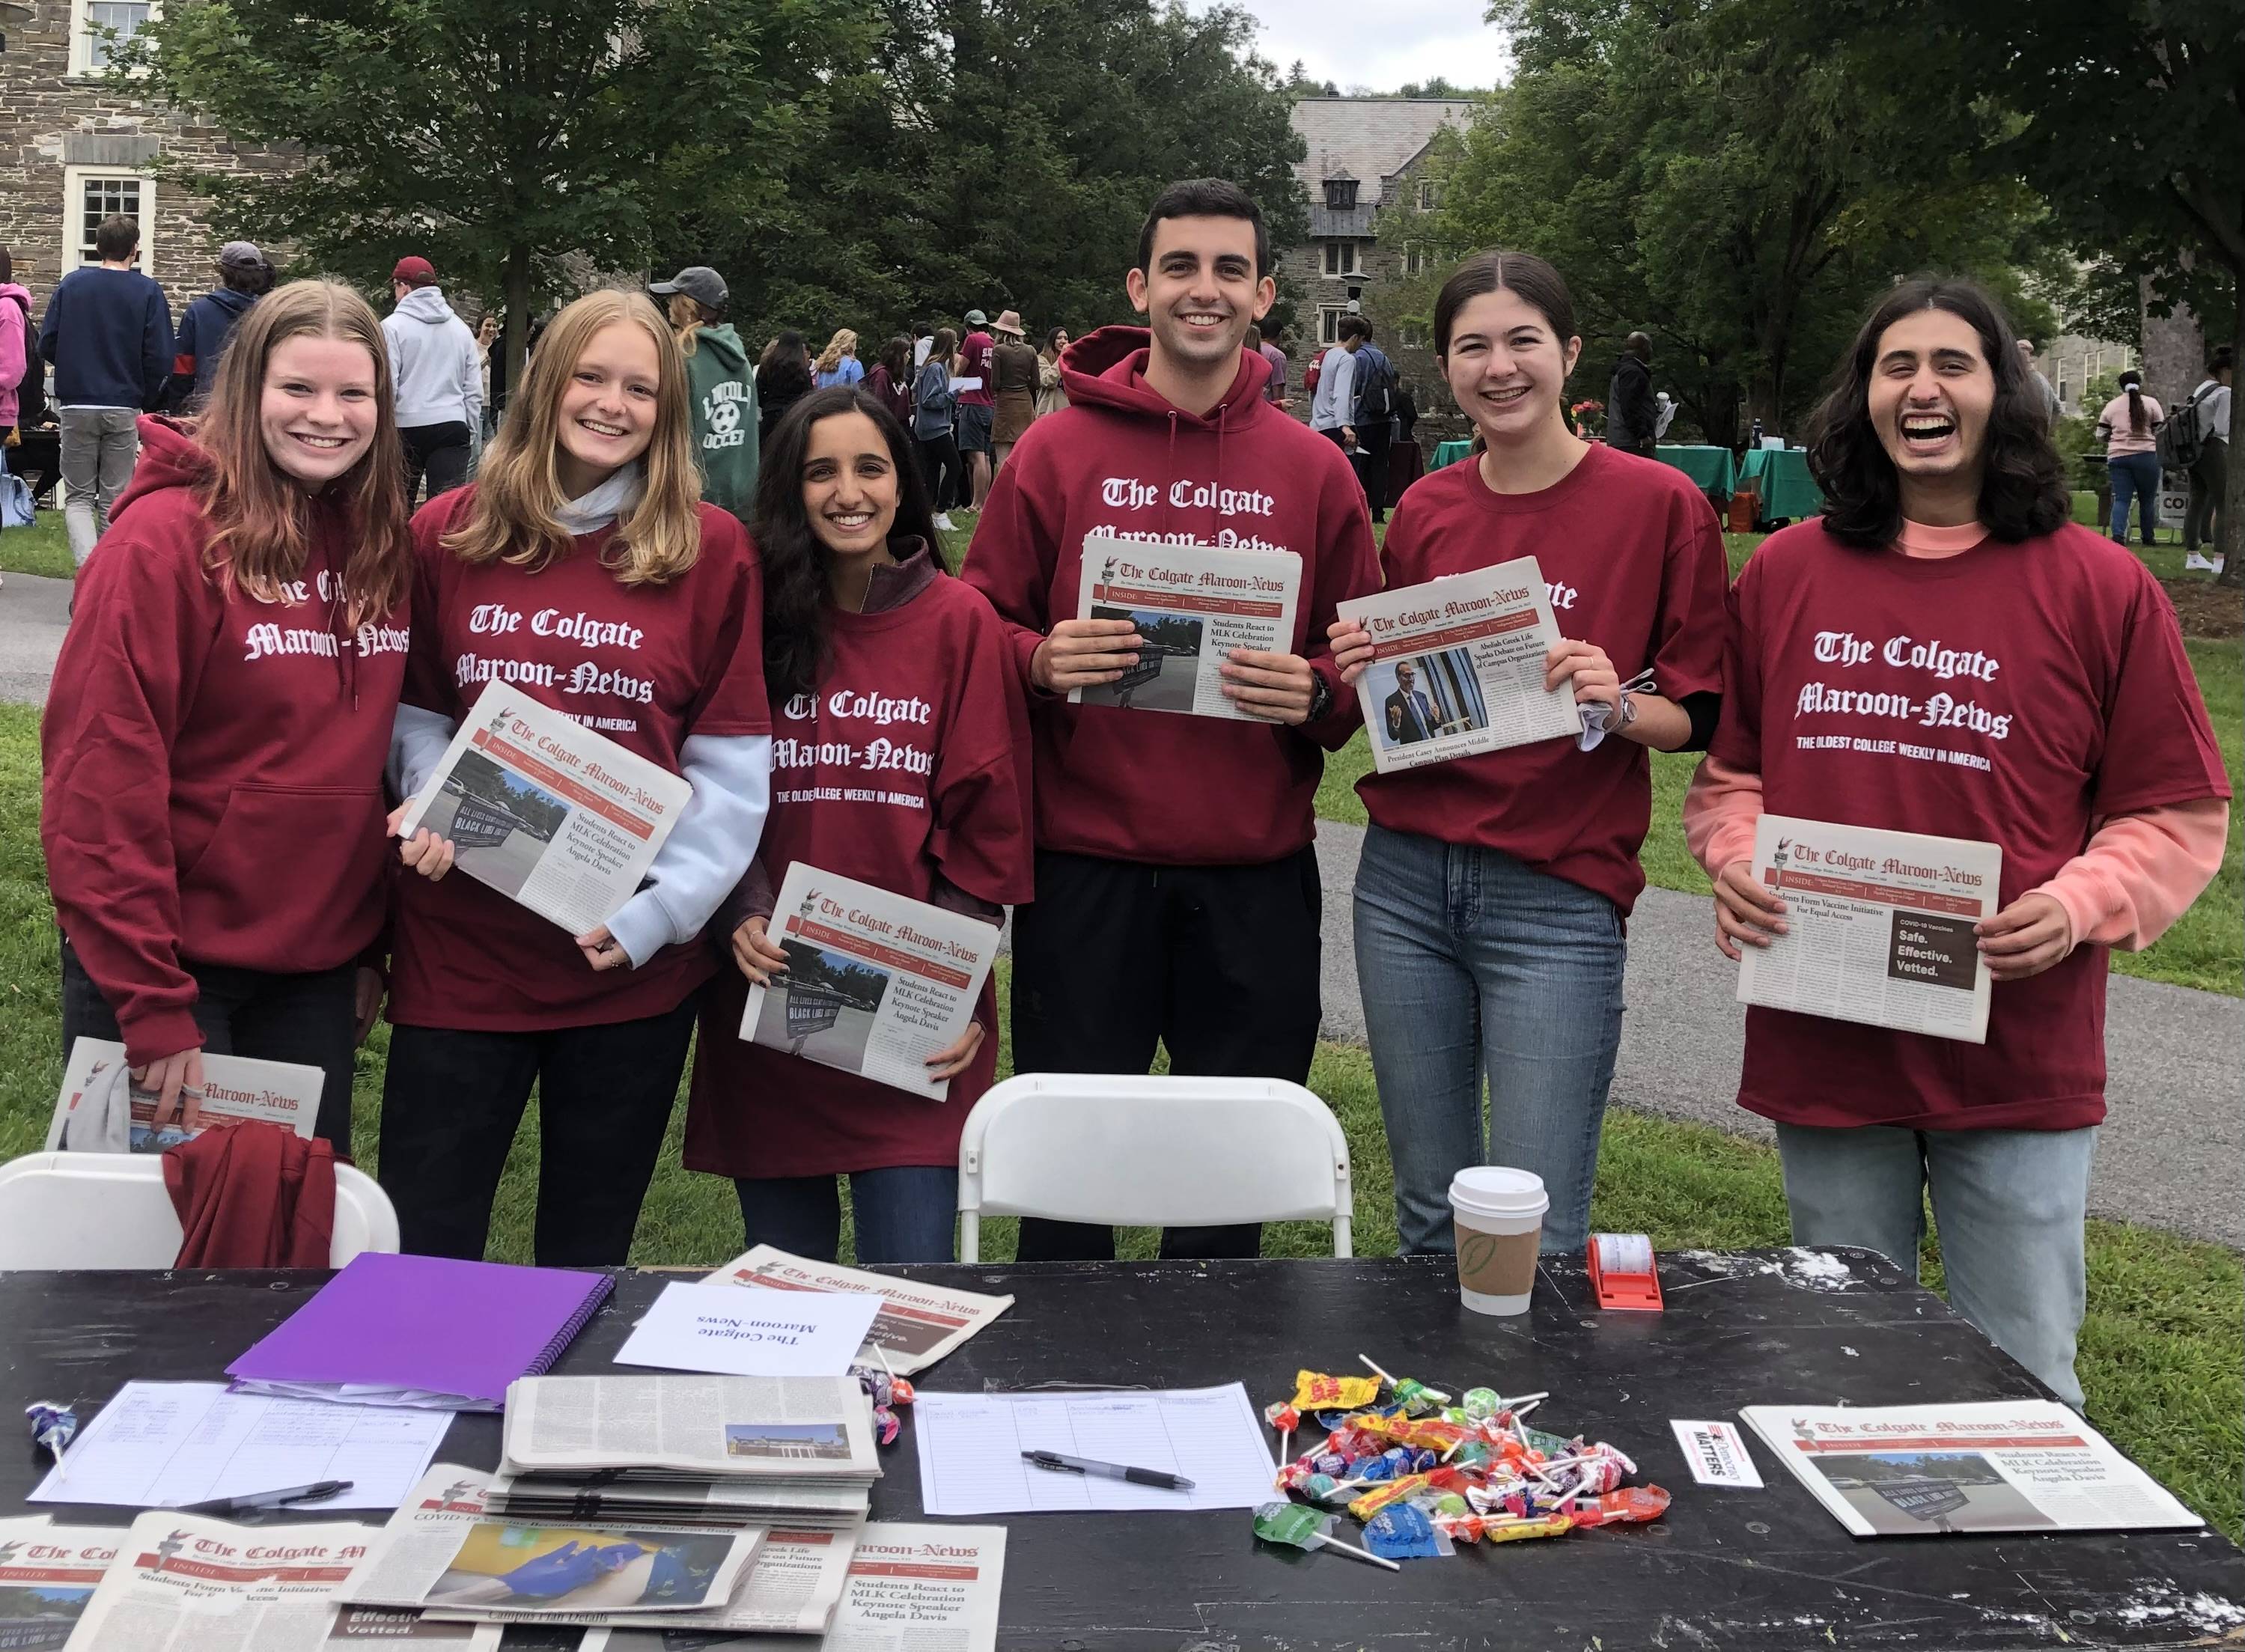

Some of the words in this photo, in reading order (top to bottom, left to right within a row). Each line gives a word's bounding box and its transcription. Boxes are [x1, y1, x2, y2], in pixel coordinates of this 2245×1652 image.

[1102, 478, 1159, 511] The
[1169, 479, 1274, 516] Colgate
[1120, 563, 1144, 579] The
[1149, 567, 1194, 585] Colgate
[1198, 572, 1285, 592] Maroon-News
[1372, 616, 1395, 632] The
[1398, 609, 1440, 627] Colgate
[1444, 585, 1530, 618] Maroon-News
[469, 603, 523, 636] The
[531, 608, 644, 650] Colgate
[1213, 619, 1244, 630] Students
[1246, 622, 1266, 631] React
[244, 623, 409, 661] Maroon-News
[1210, 629, 1231, 637] MLK
[1232, 630, 1274, 642] Celebration
[1211, 638, 1241, 649] Keynote
[1243, 640, 1272, 652] Speaker
[1481, 641, 1502, 650] Abolish
[1502, 635, 1521, 646] Greek
[1521, 633, 1533, 641] Life
[1216, 649, 1231, 659] Ang
[1474, 651, 1493, 662] Sparks
[1494, 647, 1515, 657] Debate
[1525, 641, 1545, 650] Future
[1508, 649, 1550, 663] Organizations
[1814, 631, 1874, 668] The
[1883, 635, 1999, 682] Colgate
[455, 652, 655, 704] Maroon-News
[829, 690, 930, 725] Colgate
[1794, 682, 2013, 740] Maroon-News
[583, 715, 597, 728] IN
[596, 716, 637, 732] AMERICA
[1388, 753, 1414, 763] President
[1416, 749, 1432, 757] Casey
[1434, 743, 1467, 753] Announces
[1468, 737, 1490, 746] Middle
[1410, 758, 1434, 767] Campus
[1435, 754, 1449, 763] Plan
[1449, 749, 1471, 760] Details
[1797, 737, 1815, 749] THE
[1816, 736, 1851, 749] OLDEST
[1853, 738, 1896, 754] COLLEGE
[1899, 742, 1935, 761] WEEKLY
[1937, 750, 1947, 763] IN
[1948, 752, 1991, 772] AMERICA
[511, 719, 535, 742] The
[537, 735, 582, 767] Colgate
[581, 761, 666, 815] Maroon-News
[777, 790, 789, 802] THE
[843, 788, 875, 802] WEEKLY
[877, 790, 886, 802] IN
[887, 793, 924, 809] AMERICA
[455, 817, 480, 833] BLACK
[578, 812, 606, 833] Students
[608, 829, 627, 846] React
[627, 842, 636, 850] to
[566, 832, 596, 853] Keynote
[598, 850, 624, 869] Speaker
[570, 821, 589, 837] MLK
[591, 833, 631, 861] Celebration
[566, 846, 591, 864] Angela
[592, 859, 612, 876] Davis
[1794, 844, 1820, 862] The
[1825, 850, 1876, 871] Colgate
[1880, 858, 1982, 887] Maroon-News
[1796, 904, 1808, 915] For
[1809, 906, 1830, 918] Equal
[1831, 910, 1853, 921] Access
[1801, 895, 1820, 906] Form
[1821, 899, 1850, 912] Vaccine
[1851, 903, 1884, 916] Initiative
[820, 898, 845, 918] The
[848, 909, 892, 934] Colgate
[892, 925, 979, 963] Maroon-News
[1900, 918, 1928, 928] COVID-19
[1898, 930, 1928, 944] Safe.
[1898, 945, 1952, 964] Effective.
[1896, 960, 1938, 977] Vetted.
[898, 976, 928, 993] Students
[929, 986, 949, 1000] React
[893, 986, 913, 999] MLK
[914, 993, 954, 1013] Celebration
[789, 1007, 811, 1019] BLACK
[892, 997, 921, 1015] Keynote
[922, 1006, 949, 1022] Speaker
[893, 1010, 919, 1026] Angela
[919, 1017, 939, 1031] Davis
[782, 1268, 811, 1280] The
[816, 1275, 871, 1292] Colgate
[874, 1287, 981, 1315] Maroon-News
[697, 1316, 817, 1333] Maroon-News
[698, 1328, 763, 1341] Colgate
[767, 1335, 799, 1345] The
[1815, 1422, 1853, 1433] The
[1859, 1422, 1927, 1433] Colgate
[1934, 1419, 2065, 1433] Maroon-News
[1693, 1431, 1726, 1476] MATTERS
[1893, 1495, 1929, 1508] BLACK
[414, 1513, 480, 1522] COVID-19
[28, 1546, 71, 1559] The
[194, 1538, 237, 1558] The
[246, 1545, 329, 1560] Colgate
[789, 1546, 810, 1554] Life
[856, 1543, 980, 1558] aroon-News
[138, 1572, 191, 1588] Students
[194, 1582, 225, 1593] Form
[853, 1579, 910, 1590] Students
[913, 1582, 949, 1592] React
[183, 1589, 204, 1597] For
[850, 1589, 886, 1598] MLK
[889, 1591, 965, 1602] Celebration
[852, 1599, 907, 1611] Keynote
[909, 1602, 960, 1612] Speaker
[862, 1609, 907, 1621] Angela
[909, 1612, 947, 1621] Davis
[487, 1610, 534, 1623] Campus
[567, 1612, 608, 1624] Details
